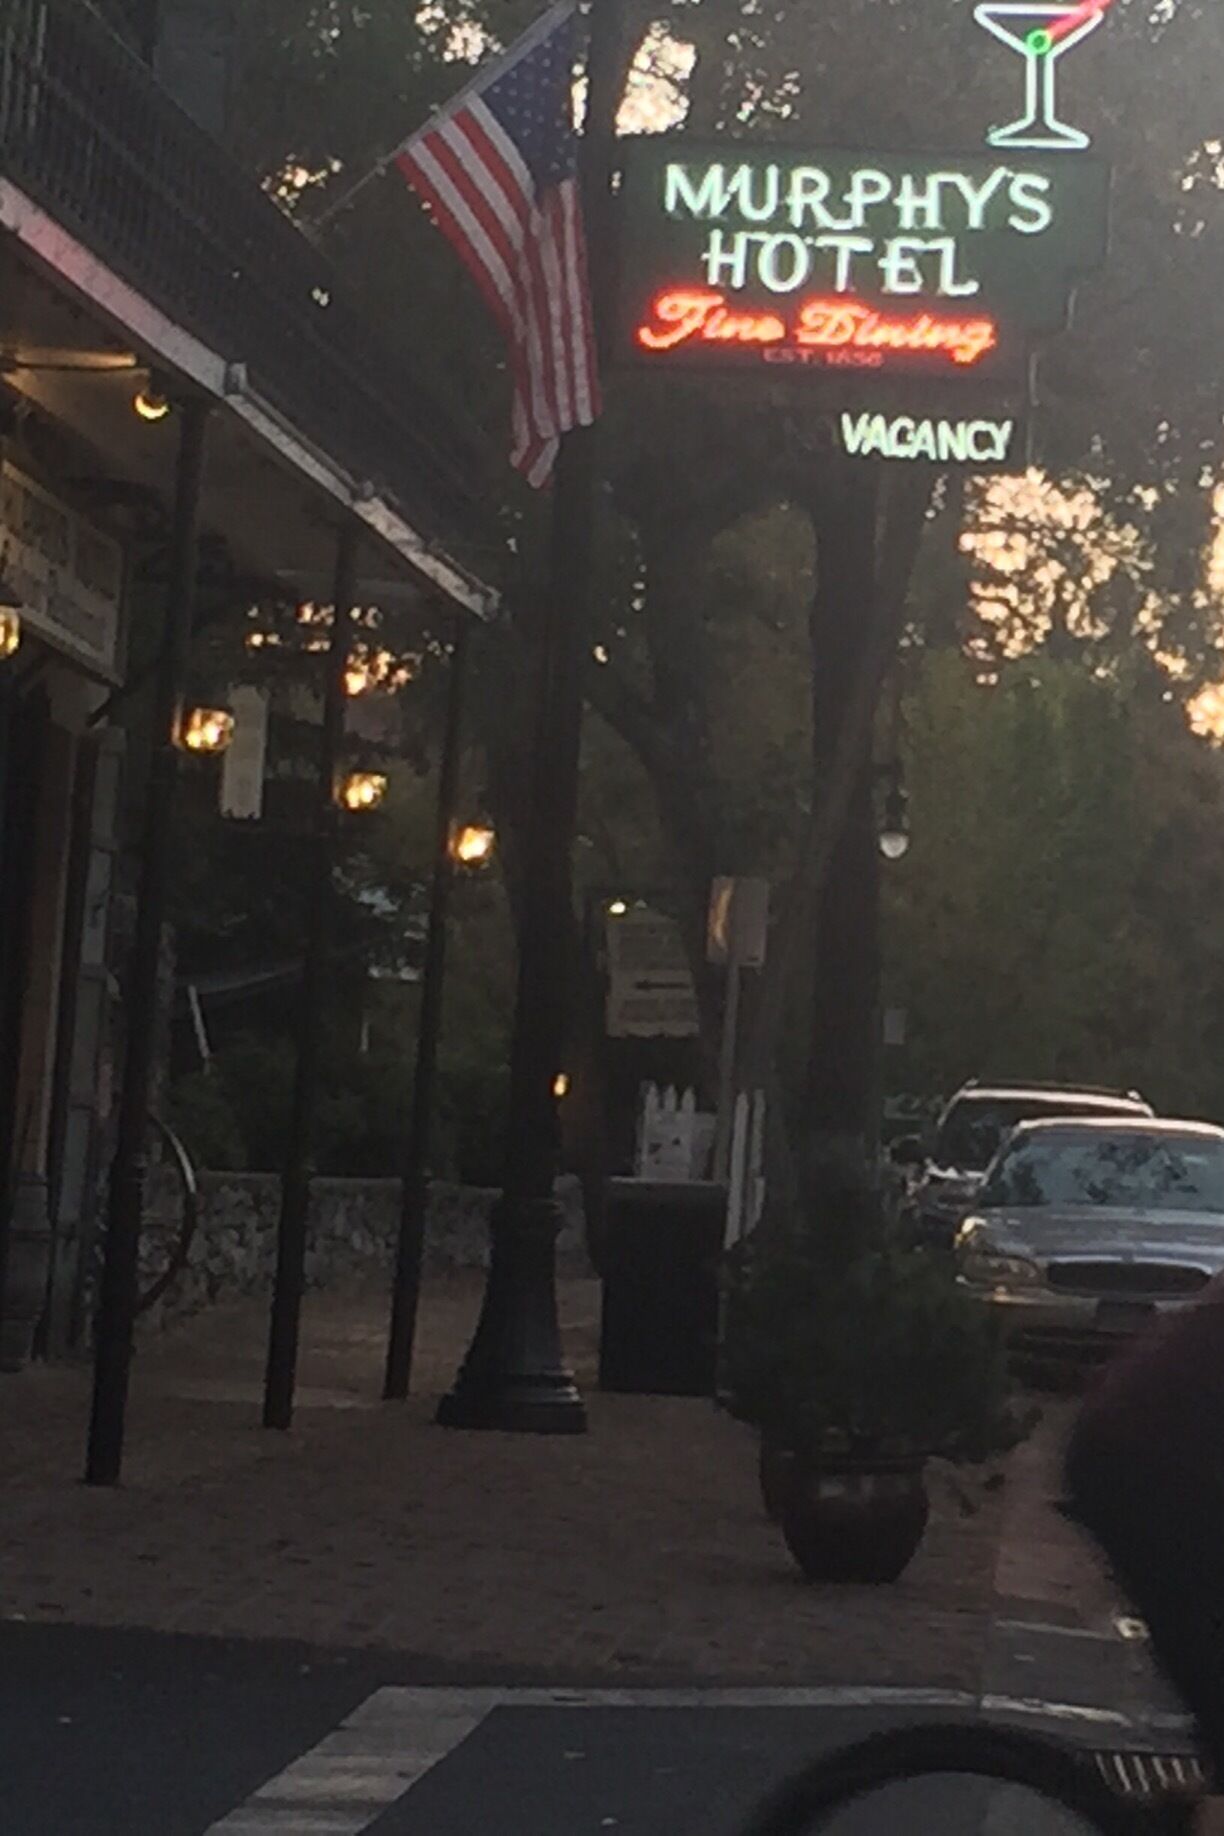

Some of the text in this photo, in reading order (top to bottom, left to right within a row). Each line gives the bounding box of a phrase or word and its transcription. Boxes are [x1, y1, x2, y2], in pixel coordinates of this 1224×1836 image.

[701, 229, 980, 295] HOTEL
[638, 291, 995, 364] Fine Dining
[841, 411, 1013, 461] VACANCY
